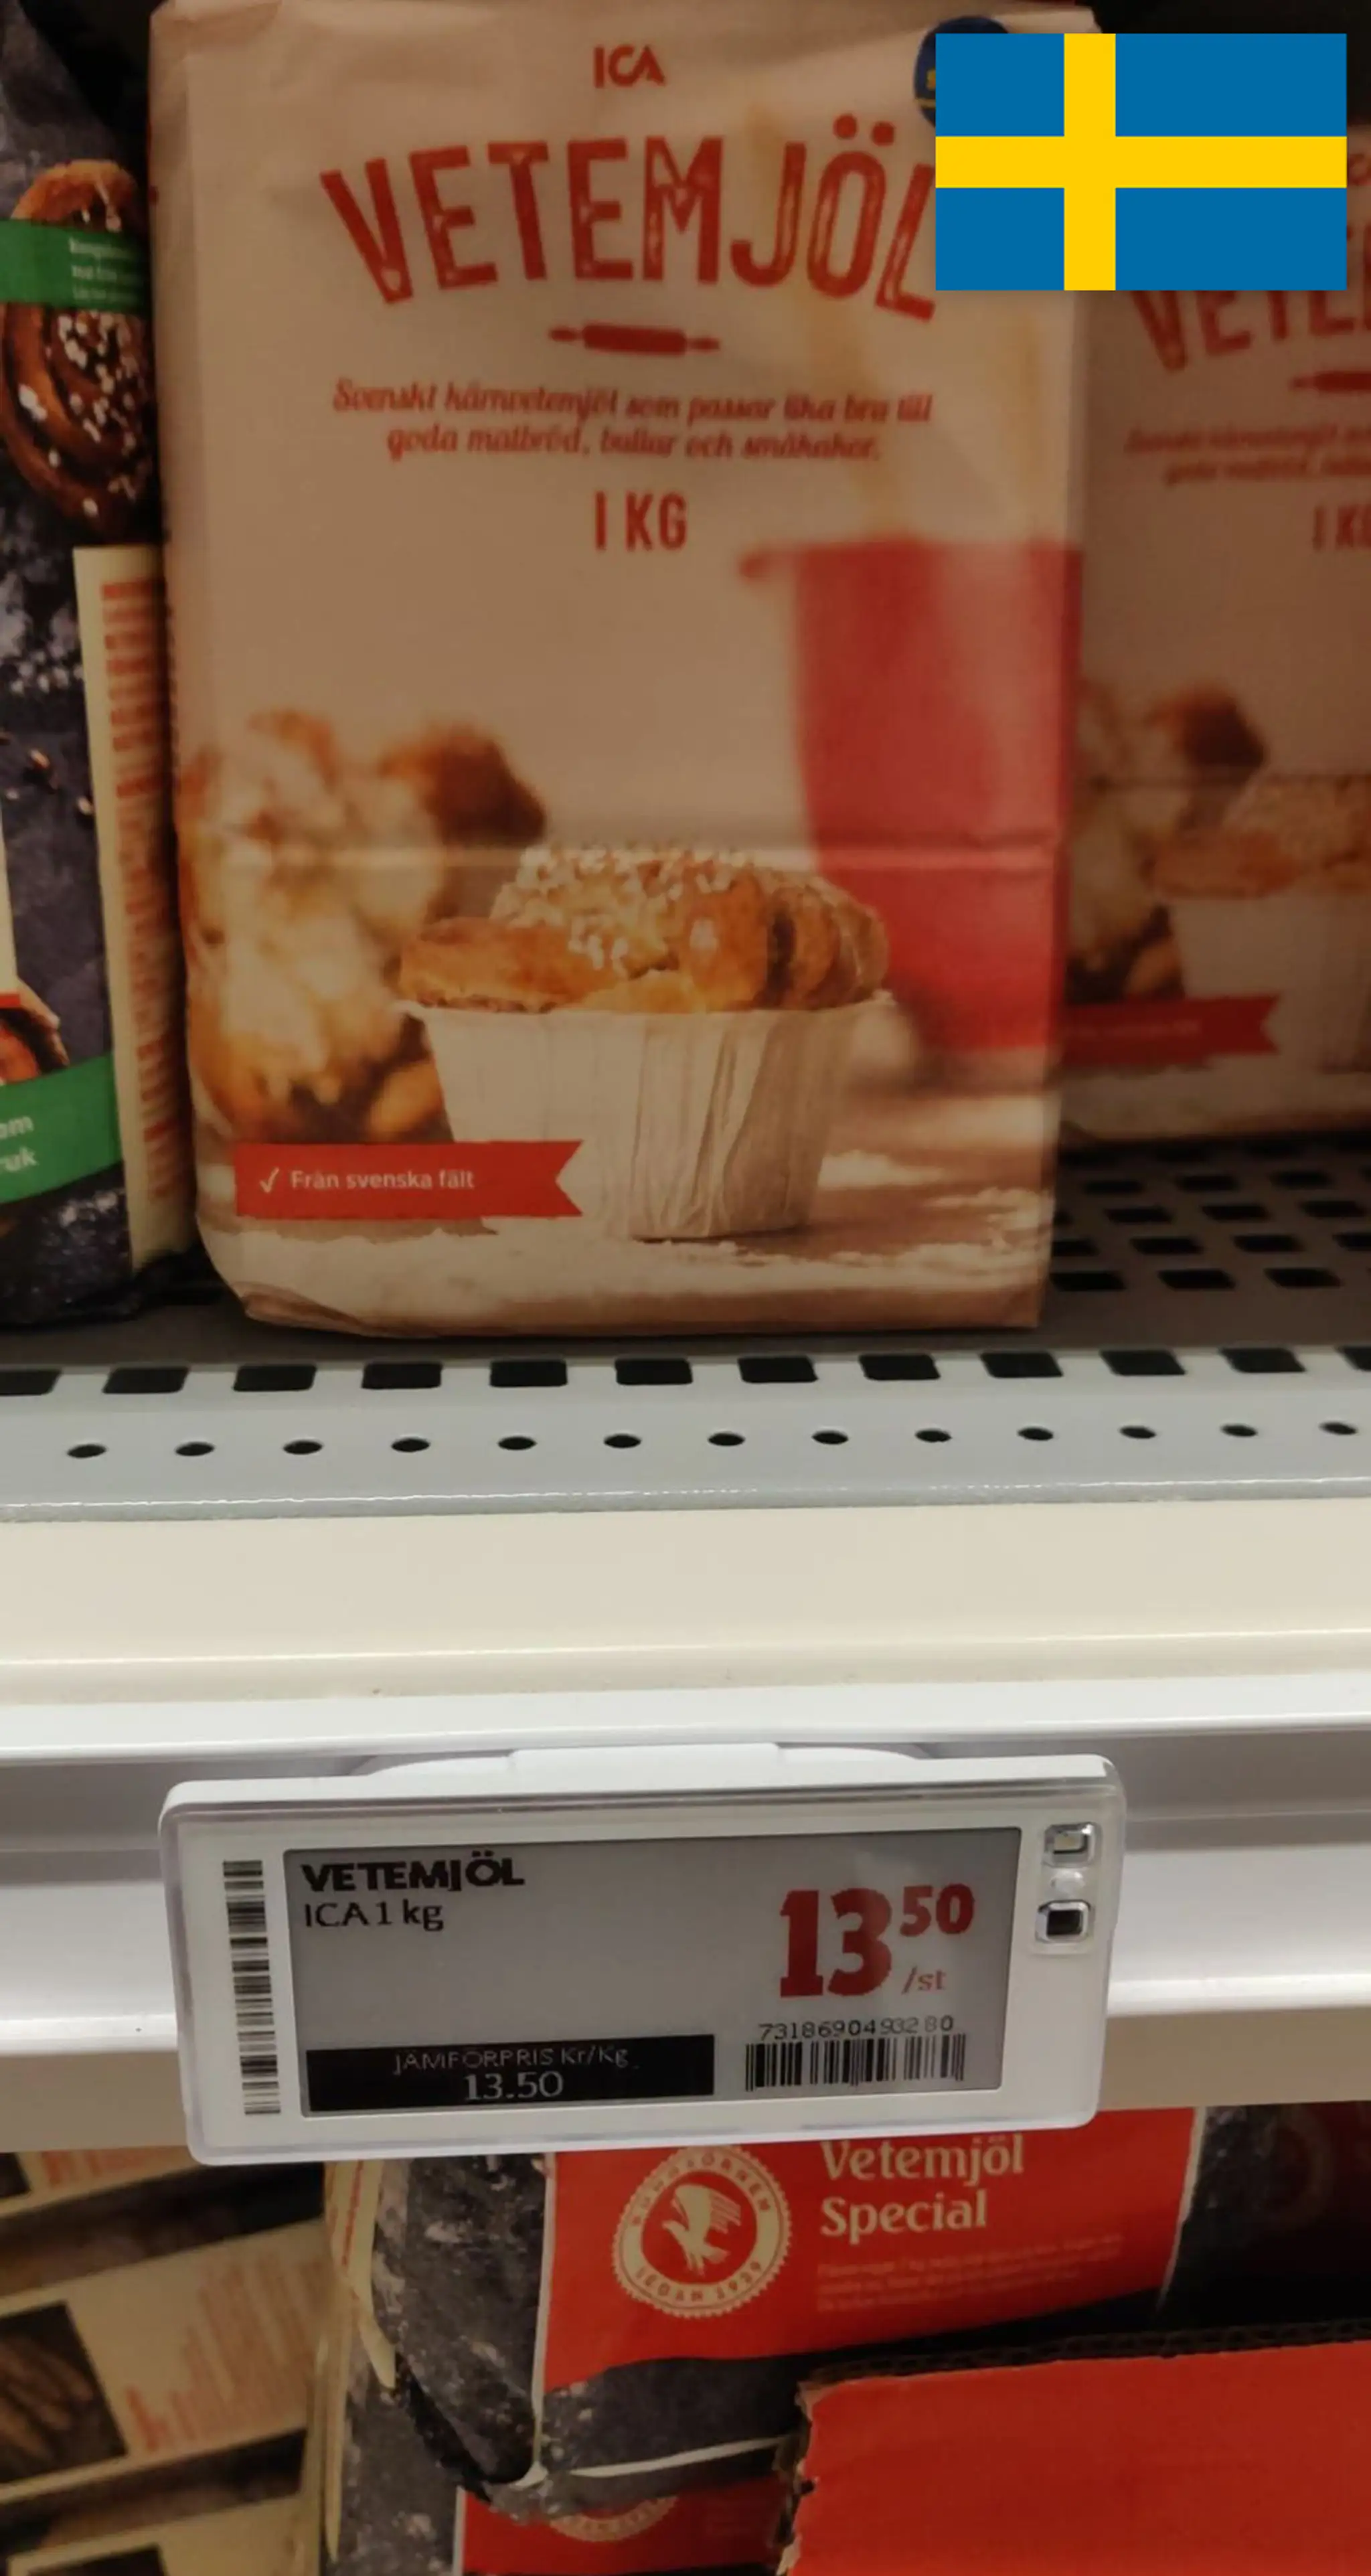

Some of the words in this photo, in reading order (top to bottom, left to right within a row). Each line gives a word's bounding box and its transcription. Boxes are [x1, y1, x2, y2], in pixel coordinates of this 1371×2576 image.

[593, 44, 665, 88] ICA
[319, 114, 937, 321] VETEMJÖL
[625, 490, 688, 553] KG
[290, 1170, 339, 1190] Från
[345, 1170, 432, 1190] svenska
[438, 1170, 475, 1189] fält
[301, 1851, 525, 1892] VETEMJÖL
[305, 1902, 369, 1927] ICA
[376, 1902, 393, 1927] 1
[403, 1899, 445, 1932] kg
[779, 1888, 893, 1998] 13
[900, 1883, 975, 1937] 50
[901, 1966, 947, 1994] /st
[465, 2071, 564, 2101] 13.50
[820, 2132, 1025, 2186] Vetemjöl
[820, 2188, 987, 2245] Special
